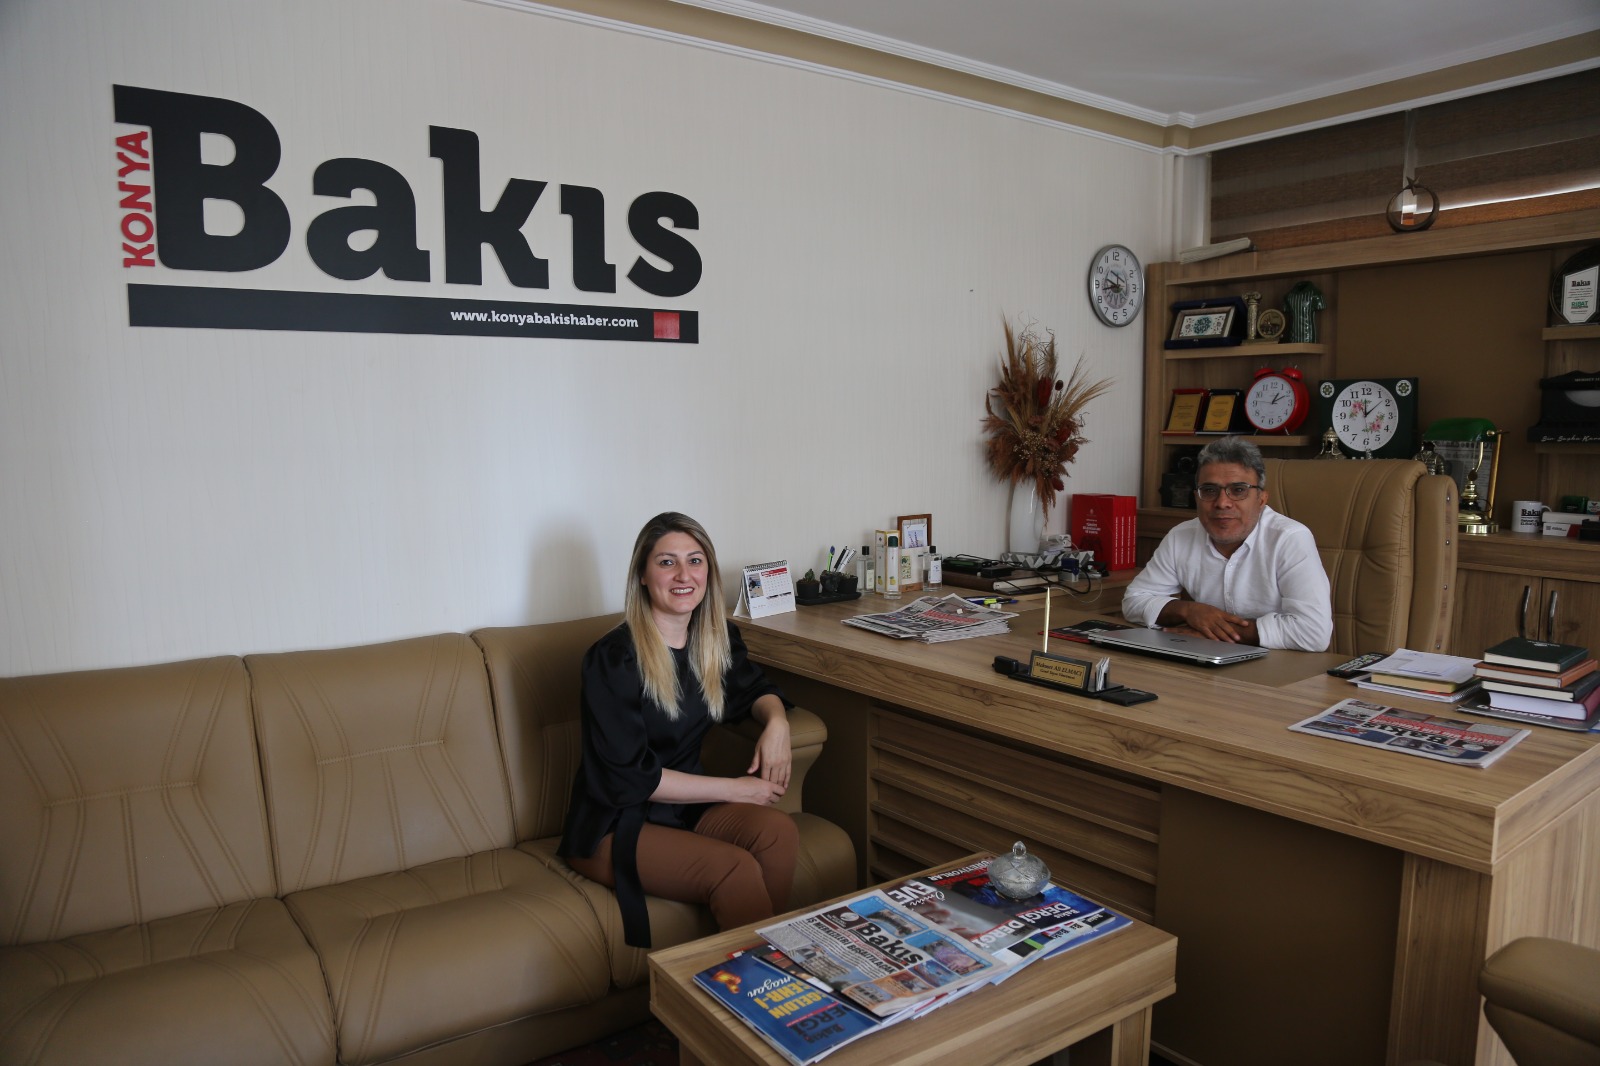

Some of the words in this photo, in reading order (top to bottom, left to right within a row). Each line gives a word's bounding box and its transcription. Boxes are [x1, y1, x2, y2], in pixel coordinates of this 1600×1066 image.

[115, 131, 156, 268] KONYA
[1104, 256, 1109, 264] 11
[1112, 251, 1120, 261] 12
[1124, 258, 1127, 266] 1
[1096, 266, 1104, 274] 10
[1129, 270, 1134, 278] 2
[1095, 280, 1100, 289] 9
[1131, 284, 1137, 293] 3
[1098, 296, 1103, 304] 8
[1129, 299, 1134, 307] 4
[1104, 307, 1109, 315] 7
[451, 310, 639, 328] www.konyabakishaber.com
[1112, 312, 1118, 320] 6
[1351, 390, 1359, 398] 11
[1361, 387, 1372, 396] 12
[1377, 390, 1382, 398] 1
[1341, 399, 1351, 407] 10
[1385, 399, 1391, 407] 2
[1342, 424, 1349, 432] 8
[1384, 424, 1389, 432] 4
[1351, 433, 1358, 441] 7
[1363, 437, 1369, 445] 6
[1018, 903, 1072, 924] DERGİ
[970, 920, 1026, 951] DERGİ
